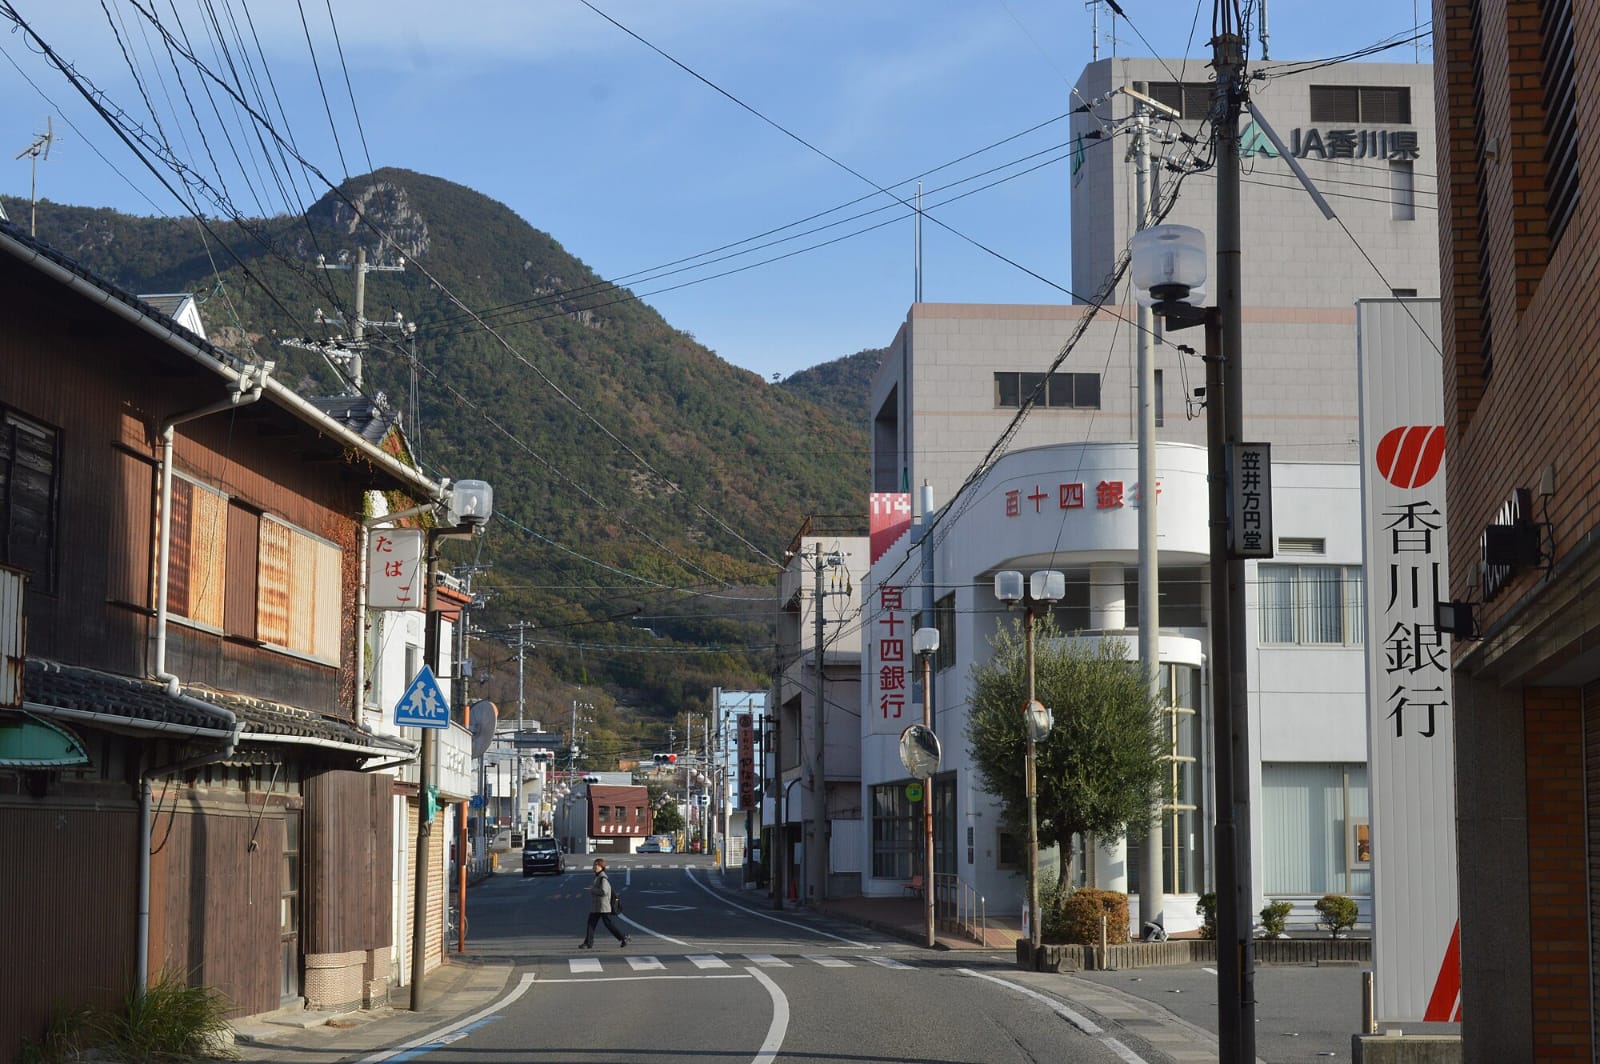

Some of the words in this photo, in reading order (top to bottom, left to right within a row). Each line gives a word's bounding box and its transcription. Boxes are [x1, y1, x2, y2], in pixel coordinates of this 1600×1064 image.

[1290, 128, 1420, 160] JA香川県
[870, 493, 911, 514] 114
[1240, 451, 1262, 551] 笠井方円堂
[375, 535, 411, 602] たばこ
[879, 585, 906, 719] 百十四銀行
[1381, 500, 1449, 738] 香川銀行
